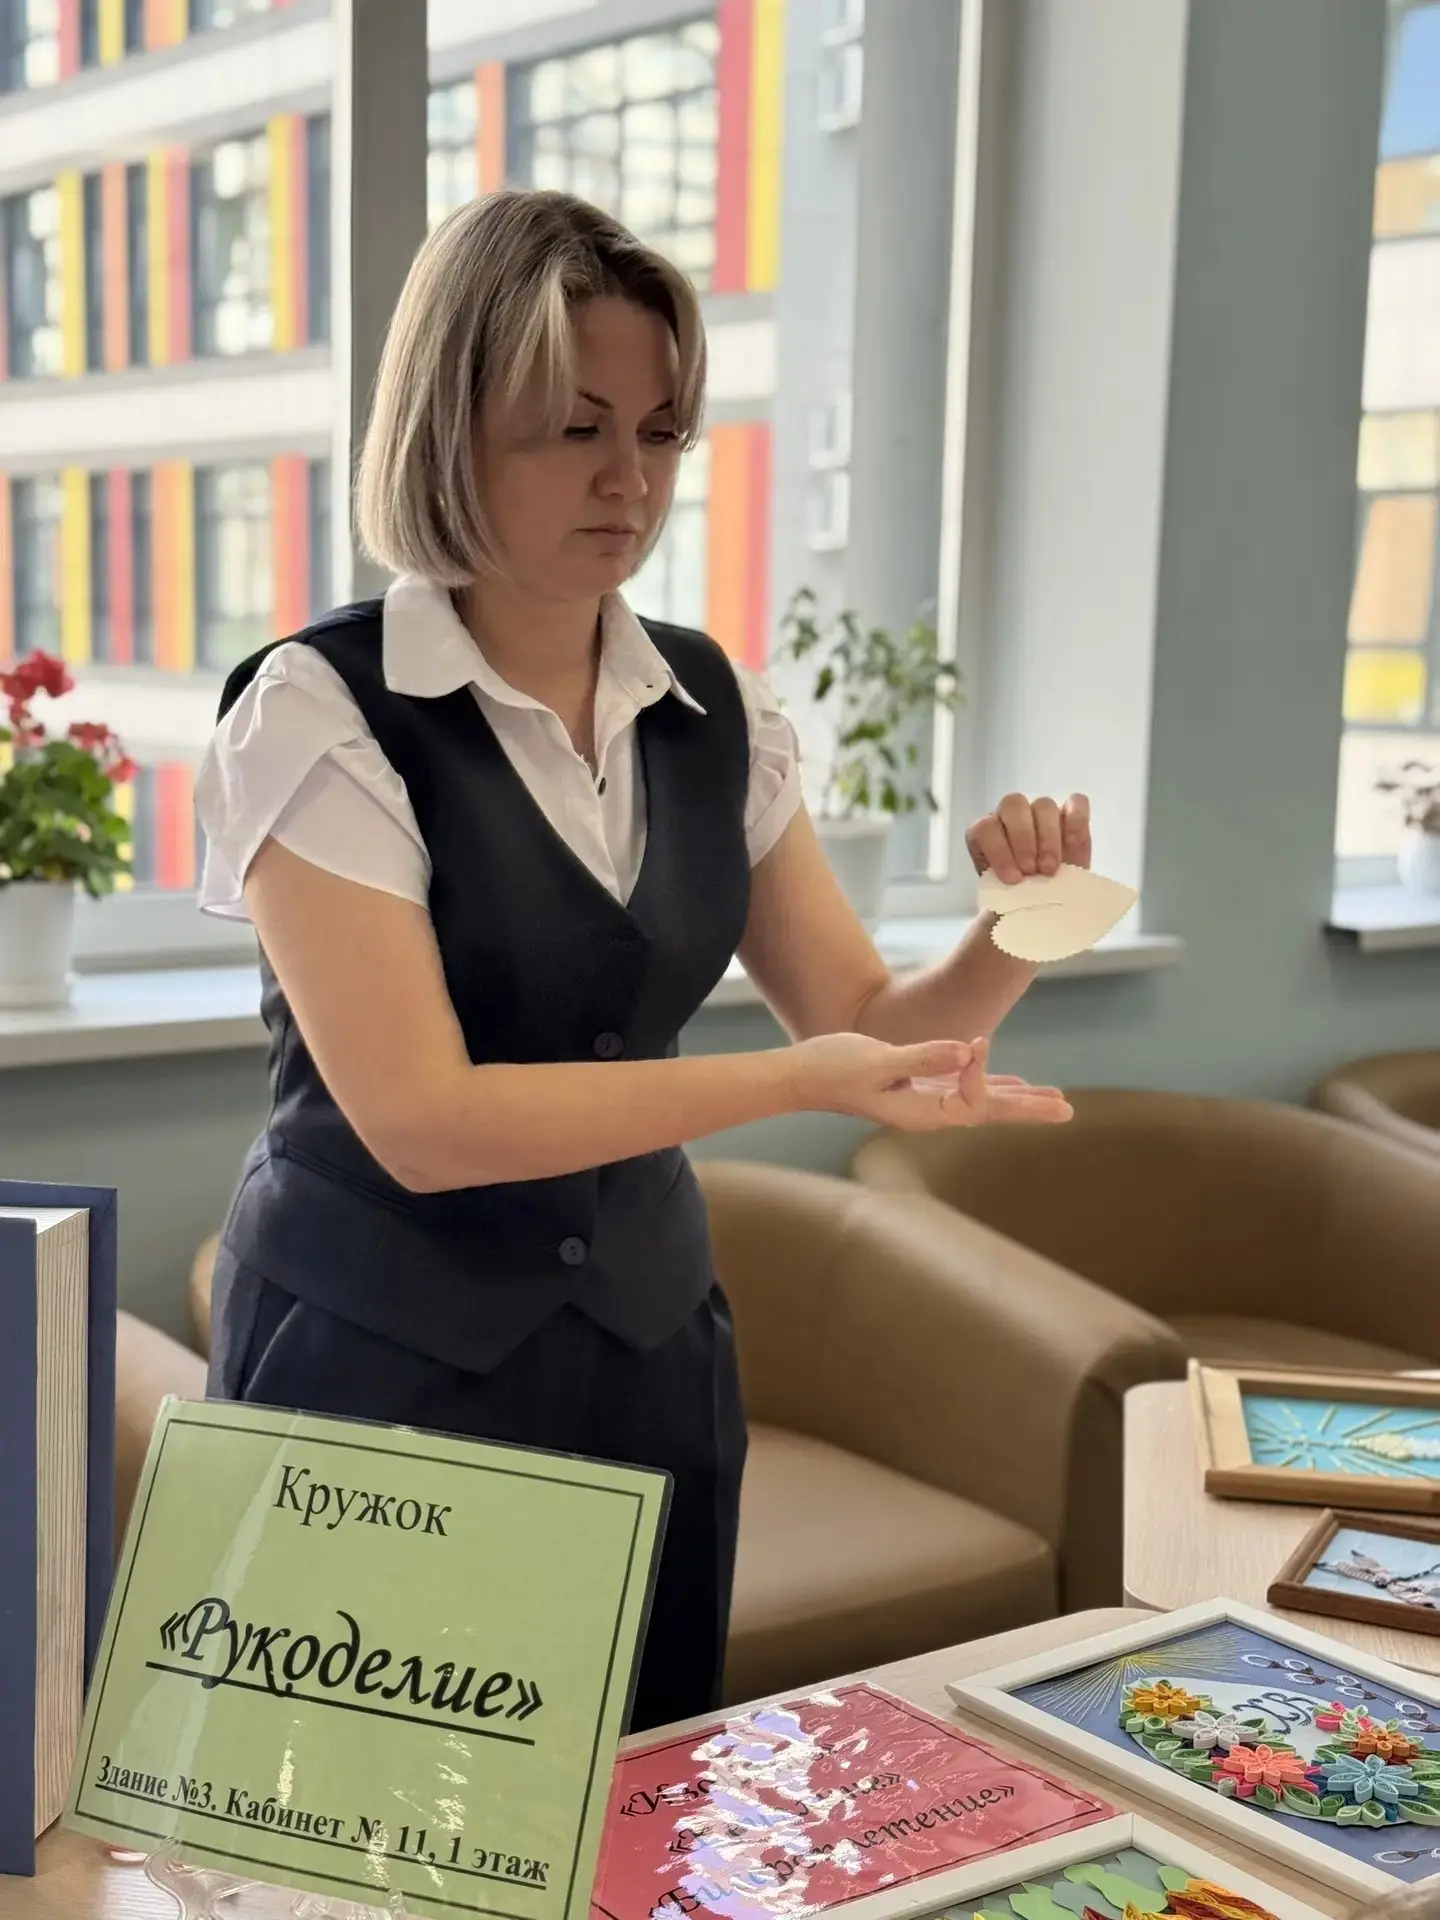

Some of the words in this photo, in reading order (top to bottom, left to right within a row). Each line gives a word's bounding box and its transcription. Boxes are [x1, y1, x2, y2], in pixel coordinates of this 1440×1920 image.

[272, 1463, 453, 1538] Кружок
[159, 1597, 544, 1722] «Рукоделие»
[97, 1755, 168, 1800] Здание
[172, 1773, 217, 1812] №3.
[224, 1785, 345, 1842] Кабинет
[395, 1825, 436, 1864] 11,
[447, 1836, 462, 1865] 1
[471, 1847, 551, 1883] этаж
